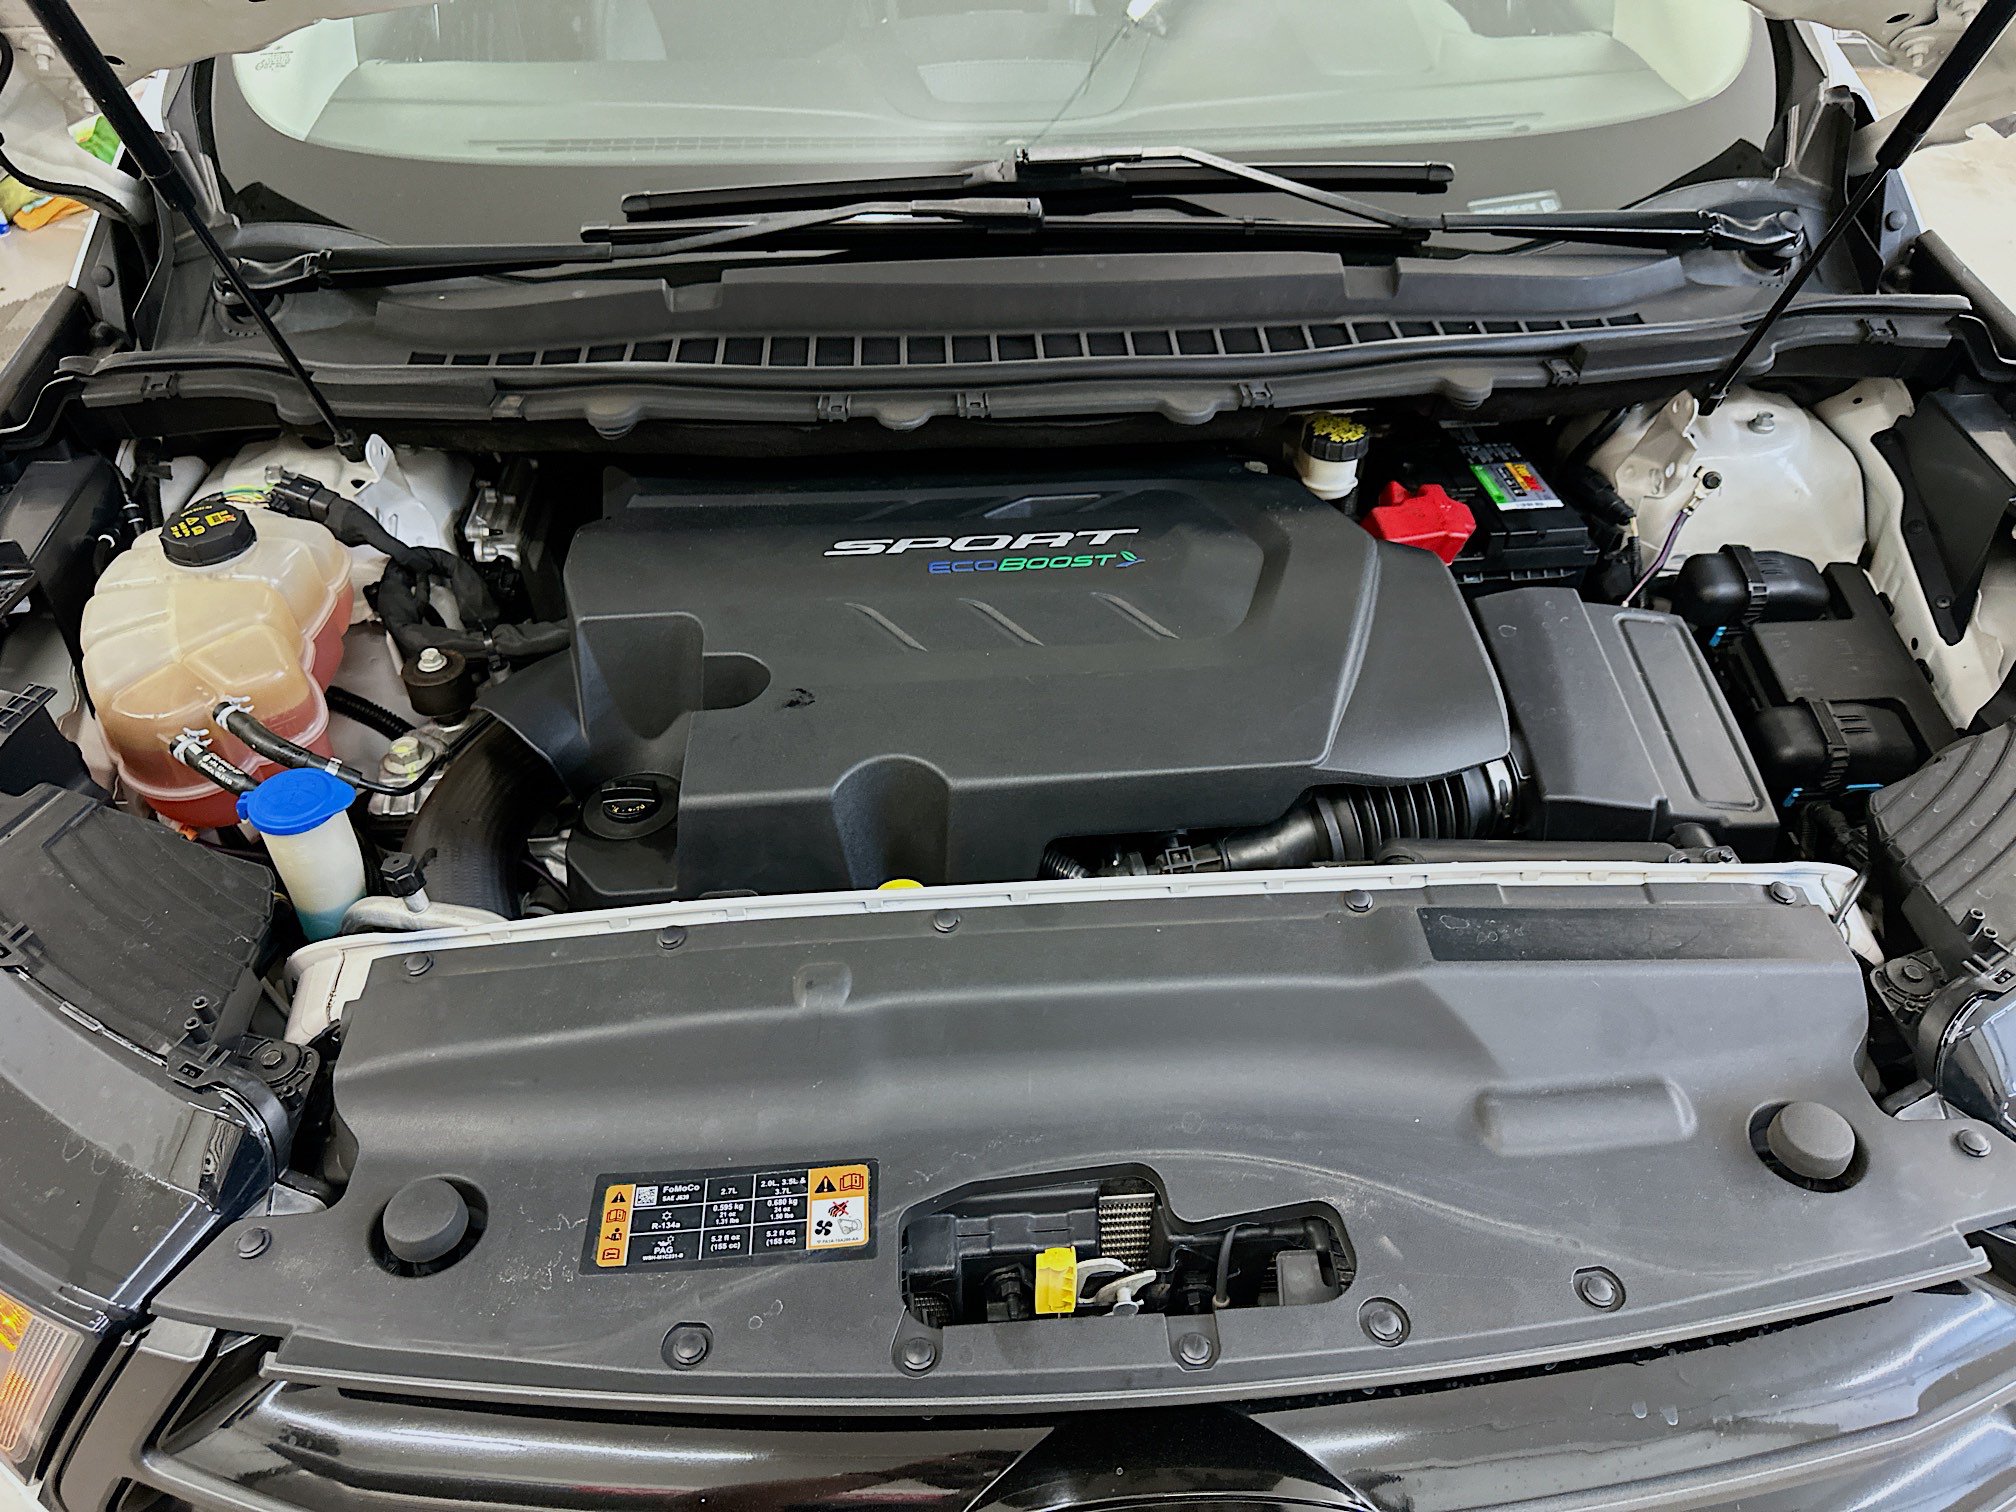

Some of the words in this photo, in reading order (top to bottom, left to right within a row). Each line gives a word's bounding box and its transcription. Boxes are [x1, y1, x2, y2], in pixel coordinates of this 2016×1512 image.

[823, 528, 1140, 557] SPORT
[928, 553, 1117, 574] ECOBOOST
[662, 1184, 701, 1194] FoMoCo
[720, 1188, 738, 1196] 2.7L
[774, 1187, 792, 1195] 3.7L
[788, 1197, 798, 1206] kg
[712, 1203, 733, 1212] 0.595
[733, 1202, 744, 1212] kg
[651, 1221, 681, 1230] R-134a
[766, 1230, 778, 1238] 5.2
[710, 1235, 723, 1243] 5.2
[765, 1237, 783, 1247] (155
[784, 1236, 797, 1245] cc)
[653, 1246, 674, 1255] PAG
[710, 1242, 728, 1252] (155
[728, 1241, 741, 1250] cc)
